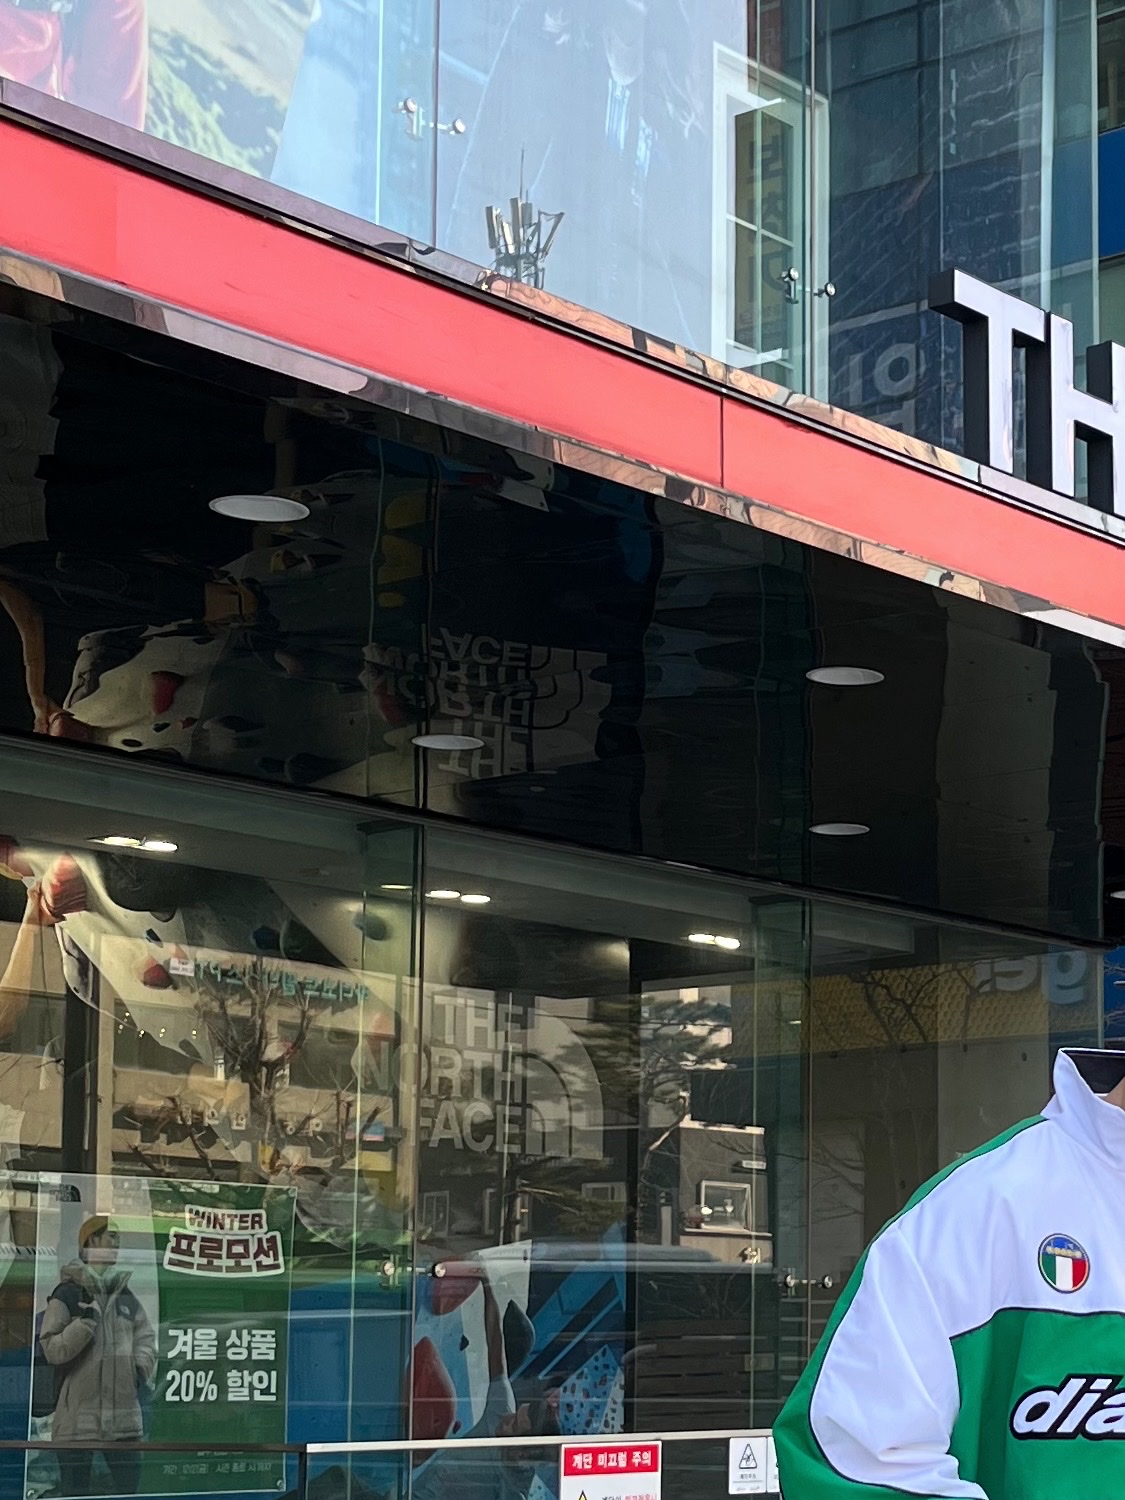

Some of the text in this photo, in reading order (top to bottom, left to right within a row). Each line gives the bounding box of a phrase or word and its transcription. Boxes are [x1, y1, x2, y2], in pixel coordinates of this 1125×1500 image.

[433, 994, 525, 1050] THE
[352, 1040, 524, 1103] NORTH
[412, 1096, 524, 1154] FACE
[166, 1231, 283, 1275] 프로모션
[167, 1328, 277, 1361] 겨울 상품
[165, 1368, 278, 1402] 20% 할인
[572, 1450, 652, 1470] 계단 미끄럼 주의
